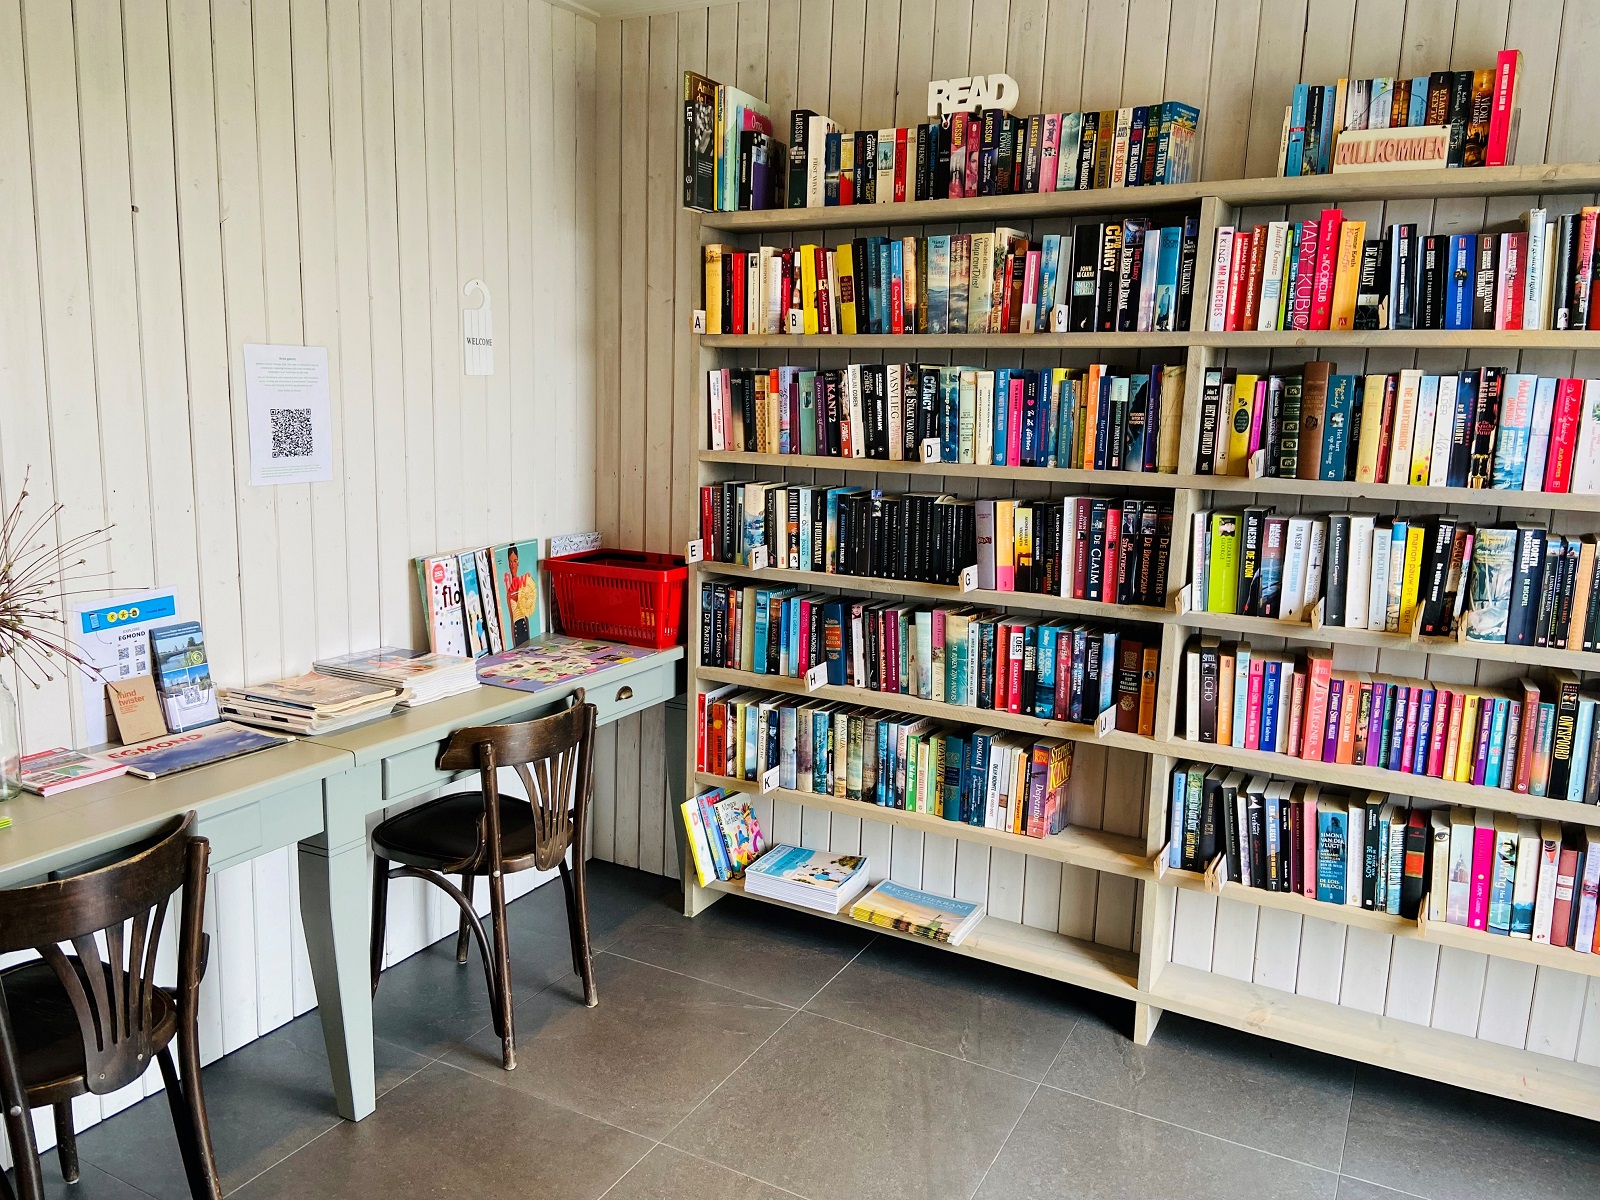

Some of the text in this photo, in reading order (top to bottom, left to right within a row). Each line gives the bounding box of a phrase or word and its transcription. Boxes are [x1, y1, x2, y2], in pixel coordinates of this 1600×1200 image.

[928, 74, 1019, 117] READ
[1429, 90, 1439, 124] FALKEN
[1437, 88, 1448, 124] SCHWUR
[1478, 96, 1491, 123] TROJA
[795, 113, 803, 142] LARSSON
[954, 115, 963, 146] LARSSON
[984, 112, 994, 143] LARSSON
[1030, 117, 1039, 147] LARSSON
[998, 132, 1006, 157] POWER
[1155, 137, 1168, 177] THE TITANS
[1337, 136, 1447, 165] WILLKOMMEN
[895, 142, 905, 179] Deaver
[1113, 141, 1125, 183] THE SEEKERS
[1128, 144, 1140, 181] THE BASTARD
[1144, 156, 1155, 181] FURIES
[1079, 160, 1090, 190] WARRIORS
[972, 238, 982, 256] Vaya
[1103, 225, 1121, 272] CLANCY
[1218, 238, 1227, 263] KING
[1274, 226, 1284, 248] Judith
[1123, 258, 1133, 274] BEER
[1124, 248, 1134, 257] DE
[1131, 248, 1142, 280] Tom Clancy
[1362, 247, 1378, 286] DE ANALIST
[1121, 279, 1131, 289] DE
[1181, 259, 1193, 295] VUURLINIE
[1214, 280, 1226, 316] MERCEDES
[1246, 277, 1256, 316] moederland
[694, 316, 702, 328] A
[791, 314, 796, 326] B
[1057, 310, 1063, 324] C
[466, 336, 493, 346] WELCOME
[827, 384, 836, 417] KANT
[890, 368, 899, 419] AASVLIEG
[923, 376, 935, 411] CLANCY
[1439, 381, 1449, 415] MULDER
[1477, 382, 1488, 413] MENDES
[1488, 382, 1496, 397] BOB
[1515, 380, 1530, 427] MACLEAN
[906, 399, 916, 418] STAAT
[1205, 405, 1216, 417] HET
[1398, 388, 1413, 451] DE HARTCHIRURG
[1504, 398, 1514, 427] OMNIBUS
[906, 419, 914, 430] VAN
[1454, 404, 1464, 444] DE MARIONET
[927, 445, 932, 457] D
[1202, 431, 1213, 454] JURYLID
[1435, 433, 1449, 457] Alex
[1555, 461, 1563, 478] MOYES
[691, 545, 696, 557] E
[754, 552, 759, 563] F
[1090, 535, 1101, 584] DE CLAIM
[1128, 543, 1133, 551] DE
[1244, 517, 1258, 578] JO NESBØ DE ZOON
[1376, 536, 1387, 581] JODI PICOULT
[1520, 531, 1532, 574] ROSENFELDT
[1530, 539, 1540, 566] HJORTH
[966, 573, 971, 586] G
[1140, 537, 1152, 594] DE BROEDERSCHAP
[1156, 538, 1169, 594] DE ERFPACHTERS
[1404, 534, 1420, 623] marion pauw DE WILDEN
[504, 572, 528, 592] flow
[1521, 586, 1529, 606] DISCIPEL
[704, 613, 710, 623] DE
[118, 630, 146, 642] EGMOND
[810, 673, 816, 686] H
[1204, 676, 1213, 701] ECHO
[117, 689, 137, 700] mind
[118, 695, 146, 706] twister
[1236, 694, 1244, 719] Hartslag
[1310, 706, 1319, 745] VLIEGENIER
[1435, 722, 1444, 735] STEEL
[1554, 716, 1573, 760] ONTSPOORD
[108, 733, 203, 758] EGMOND
[1051, 741, 1073, 764] STEPHEN
[937, 742, 945, 778] KONSALIK
[1048, 756, 1072, 792] KING
[764, 777, 771, 789] K
[1033, 784, 1044, 822] Desperation
[886, 885, 972, 911] RECREATIEKRANT
